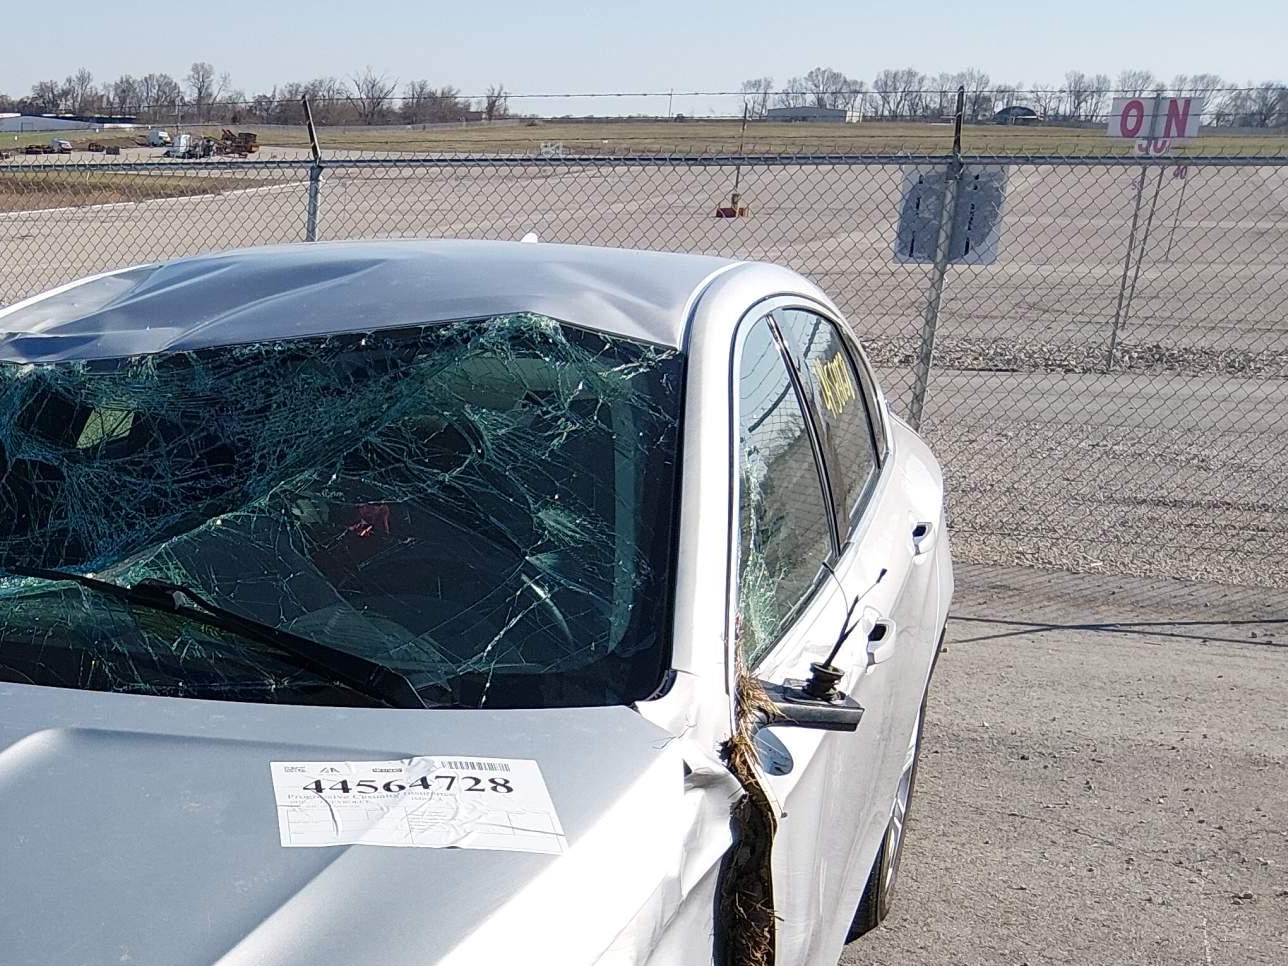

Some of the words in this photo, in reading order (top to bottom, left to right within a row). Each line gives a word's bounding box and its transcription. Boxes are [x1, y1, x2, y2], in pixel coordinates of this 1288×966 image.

[1120, 100, 1144, 138] O
[1163, 99, 1191, 138] N
[302, 776, 514, 794] 44564728
